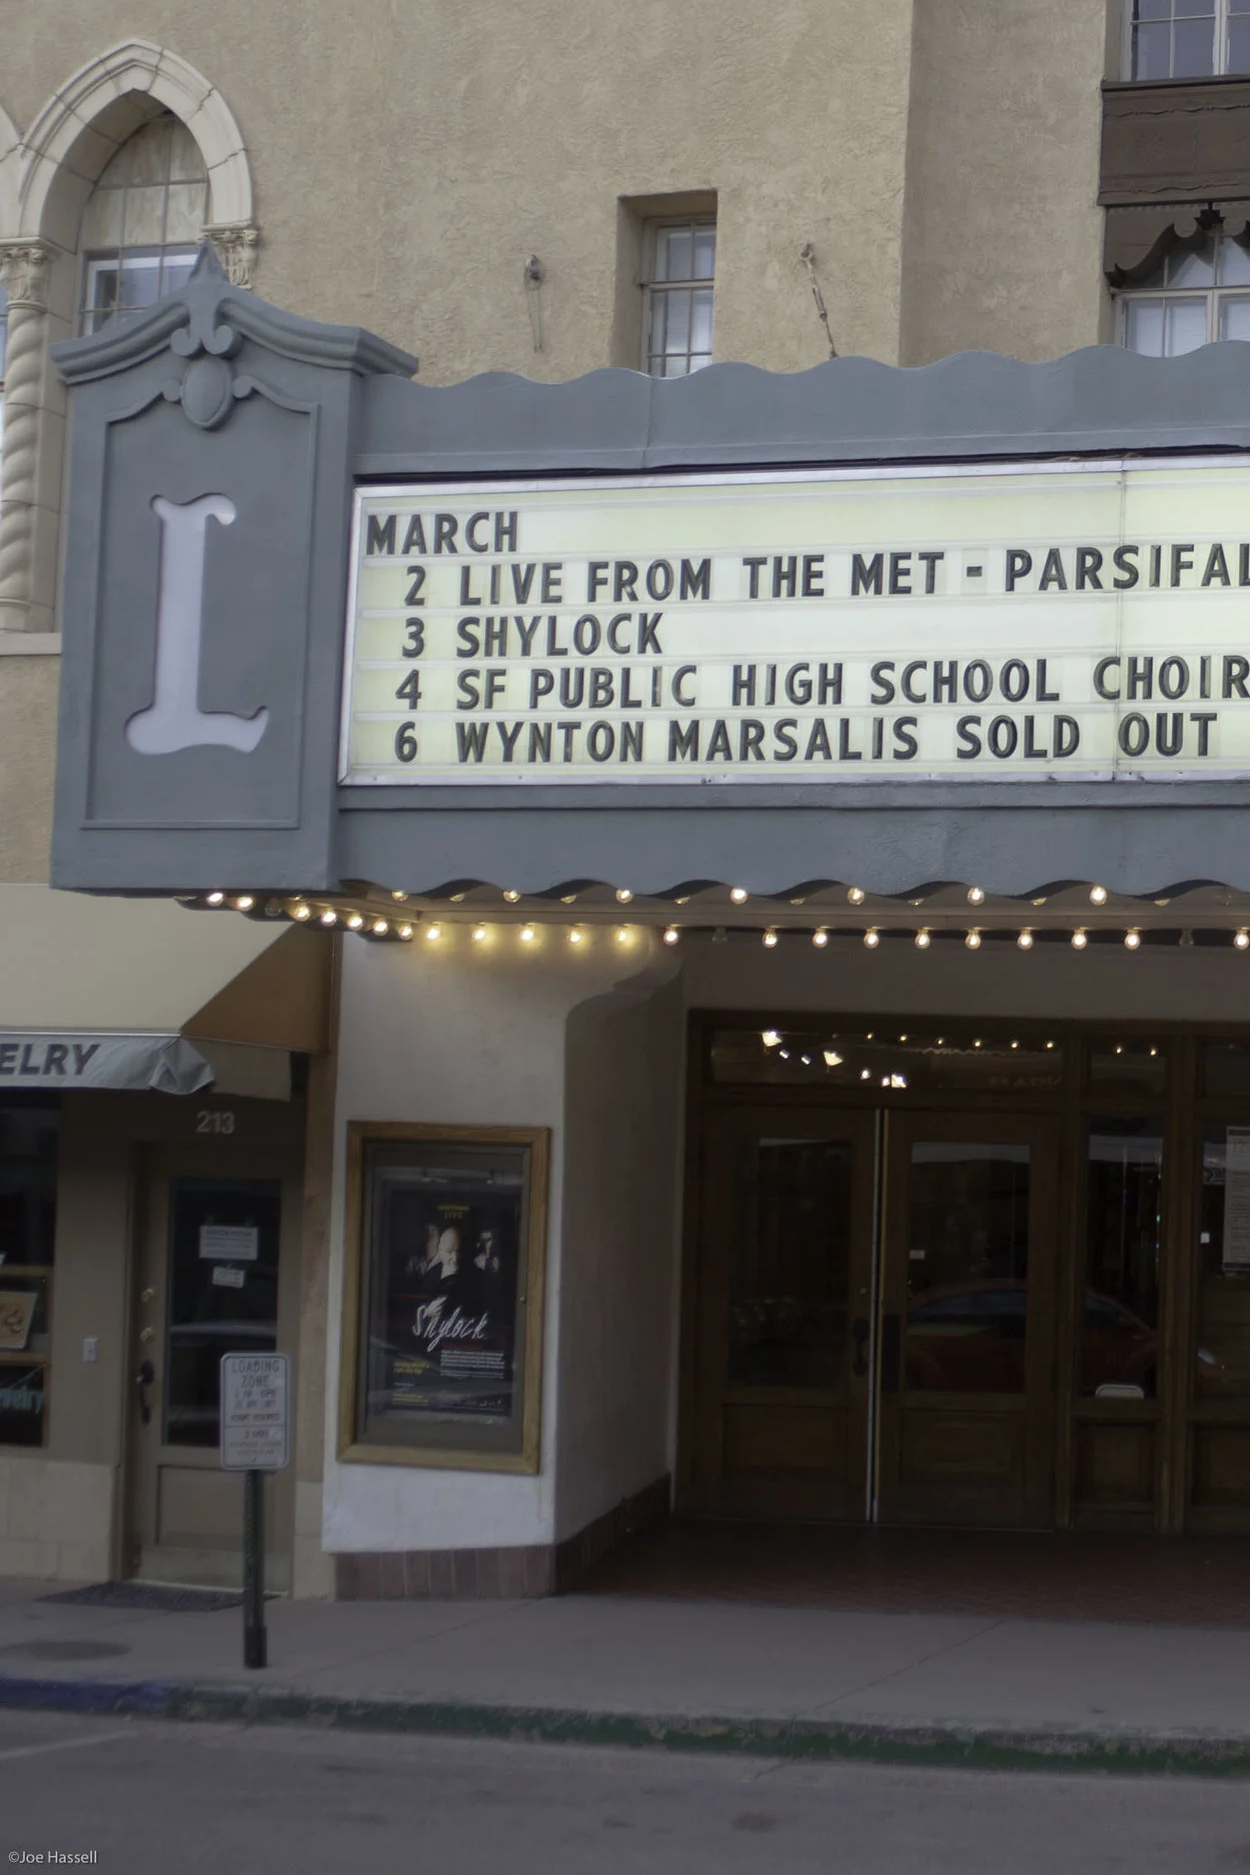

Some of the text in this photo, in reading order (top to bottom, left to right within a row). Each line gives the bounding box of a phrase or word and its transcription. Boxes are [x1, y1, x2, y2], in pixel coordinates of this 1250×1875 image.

[366, 511, 519, 555] MARCH
[404, 564, 426, 606] 2
[459, 562, 563, 605] LIVE
[587, 558, 711, 603] FROM
[742, 554, 825, 599] THE
[851, 551, 944, 596] MET
[966, 565, 983, 577] -
[402, 612, 664, 658] 3 SHYLOCK
[395, 669, 422, 710] 4
[456, 668, 508, 710] SF
[529, 665, 697, 709] PUBLIC
[732, 662, 843, 707] HIGH
[870, 658, 1060, 705] SCHOOL
[394, 712, 1218, 763] 6 WYNTON MARSALIS SOLD OUT
[0, 1043, 101, 1075] ELRY
[195, 1111, 235, 1135] 213
[412, 1304, 489, 1353] Shylock
[231, 1359, 280, 1373] LOADING
[241, 1375, 271, 1388] ZONE
